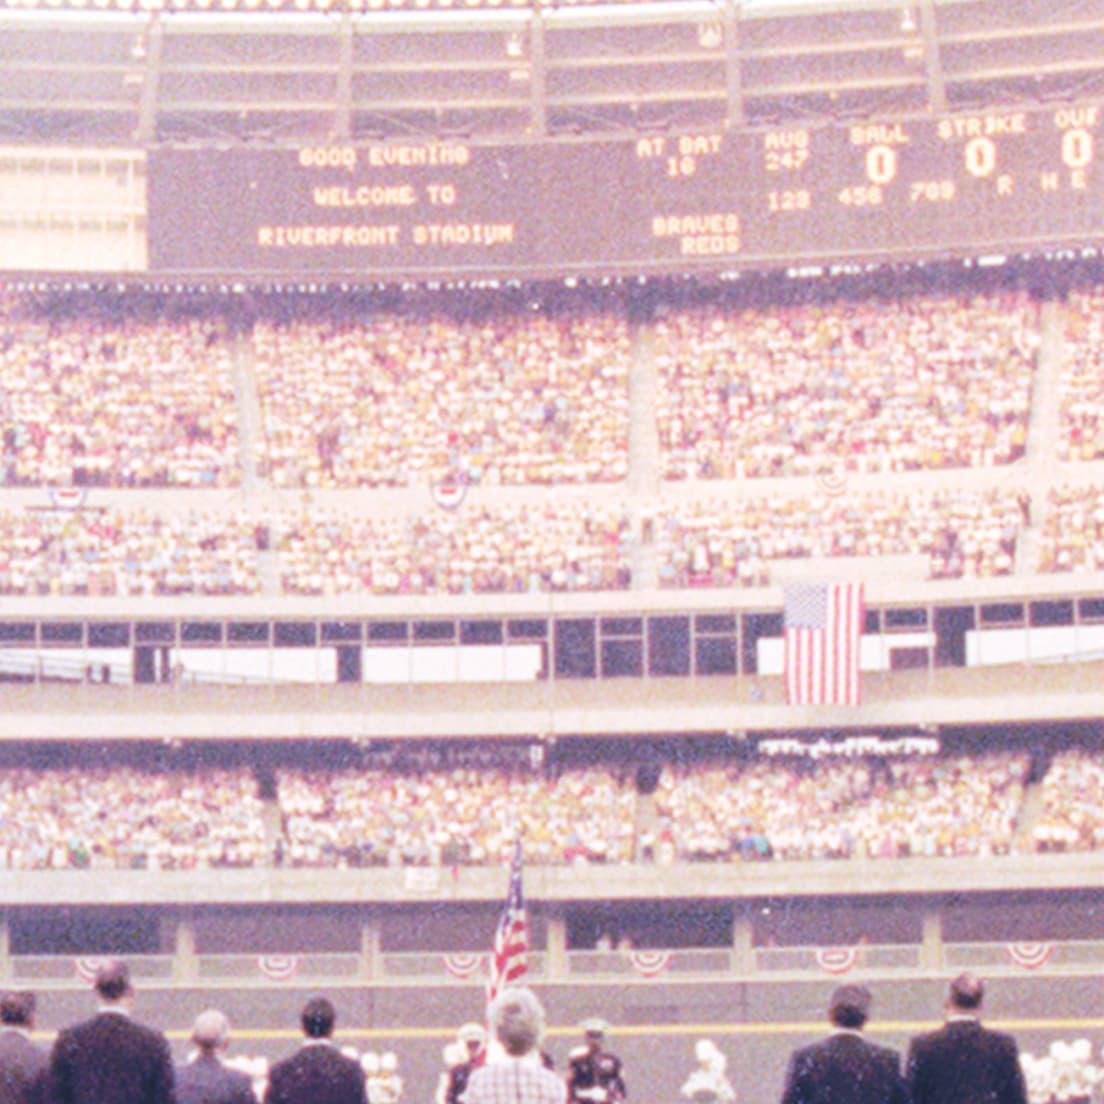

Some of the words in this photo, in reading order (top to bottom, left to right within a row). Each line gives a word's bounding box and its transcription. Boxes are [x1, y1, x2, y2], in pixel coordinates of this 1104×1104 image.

[850, 124, 910, 146] BALL
[937, 113, 1026, 140] STRIKE
[636, 137, 665, 157] AT
[679, 134, 722, 156] BAT
[764, 130, 809, 150] AVG
[1061, 128, 1093, 169] 0
[299, 146, 357, 168] GOOD
[368, 143, 470, 167] EVENING
[865, 143, 897, 186] 0
[964, 136, 996, 178] 0
[997, 174, 1014, 195] R
[1040, 171, 1058, 191] H
[1070, 169, 1087, 190] E
[313, 184, 416, 207] WELCOME
[427, 183, 457, 205] TO
[257, 225, 401, 247] RIVERFRONT
[412, 222, 514, 246] STADIUM
[651, 213, 738, 237] BRAVES
[681, 233, 740, 255] REDS
